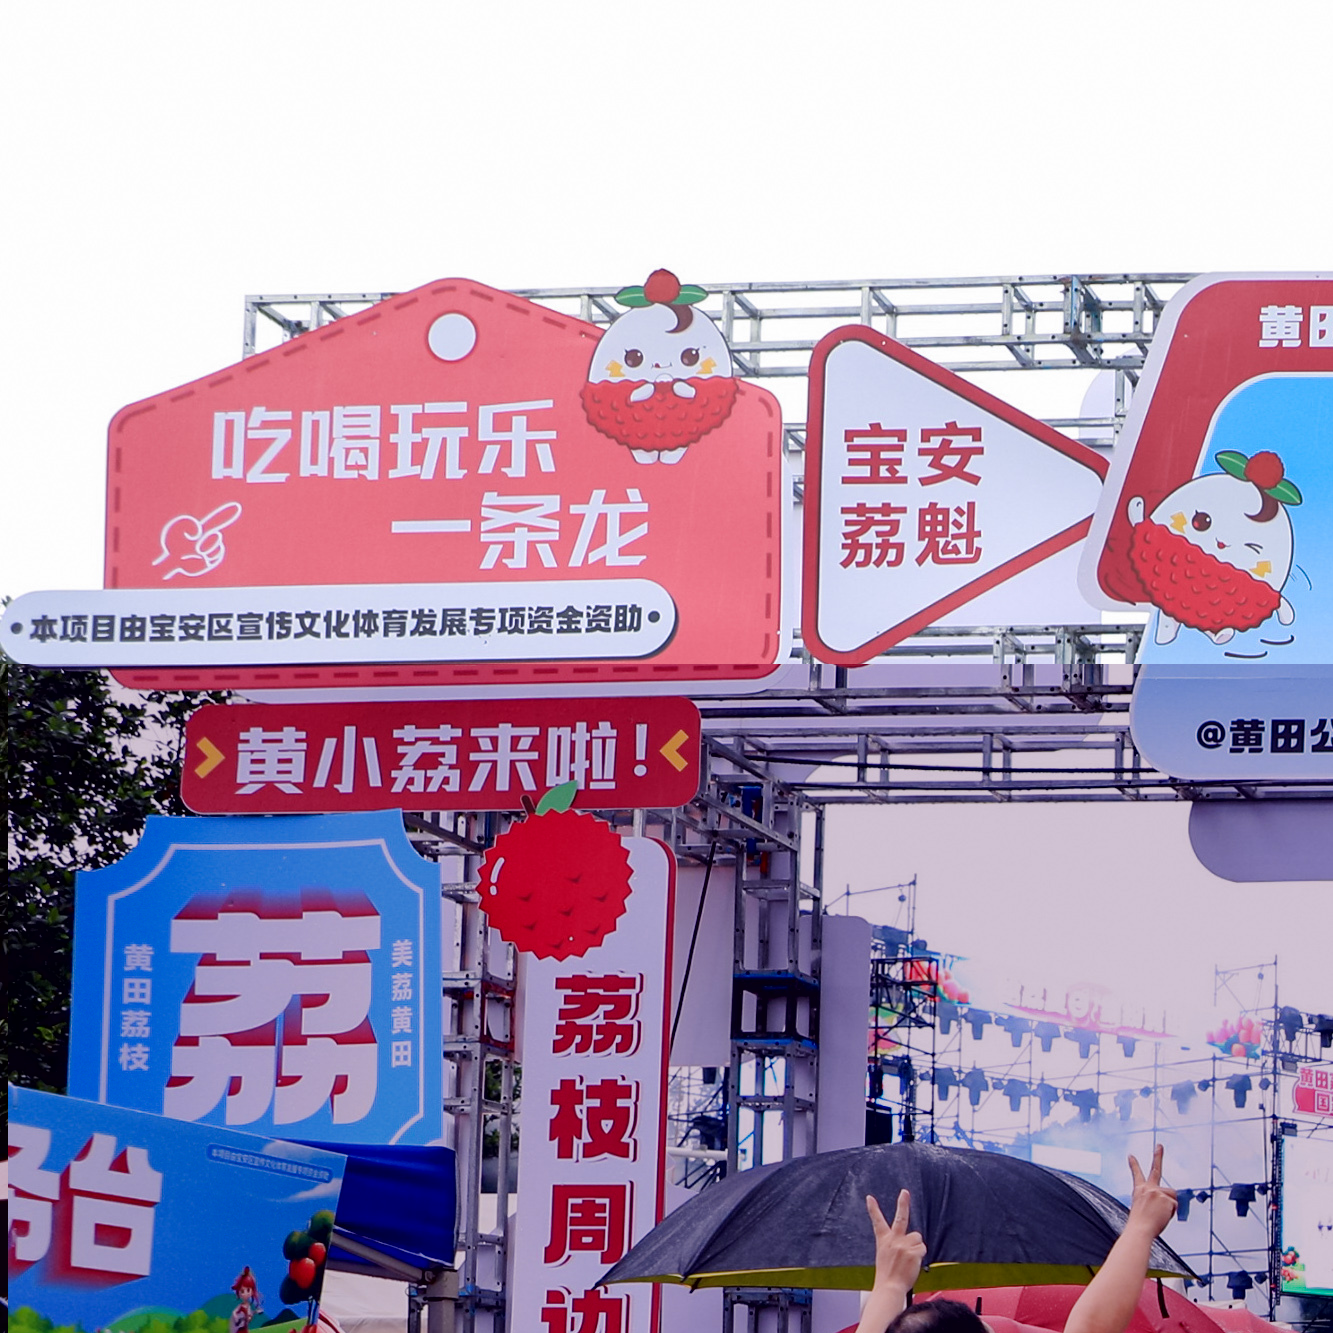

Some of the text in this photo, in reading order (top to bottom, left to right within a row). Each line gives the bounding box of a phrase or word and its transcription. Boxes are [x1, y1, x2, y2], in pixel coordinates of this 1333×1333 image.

[211, 399, 557, 483] 吃喝玩乐
[840, 421, 985, 488] 宝安
[391, 488, 649, 570] 一条龙
[840, 501, 984, 570] 荔魁
[29, 608, 644, 645] 本项目由宝安区宣传文化体育发展专项资金资助
[118, 943, 154, 1073] 黄田荔枝
[162, 910, 381, 1125] 荔
[390, 938, 414, 1068] 美荔黄田
